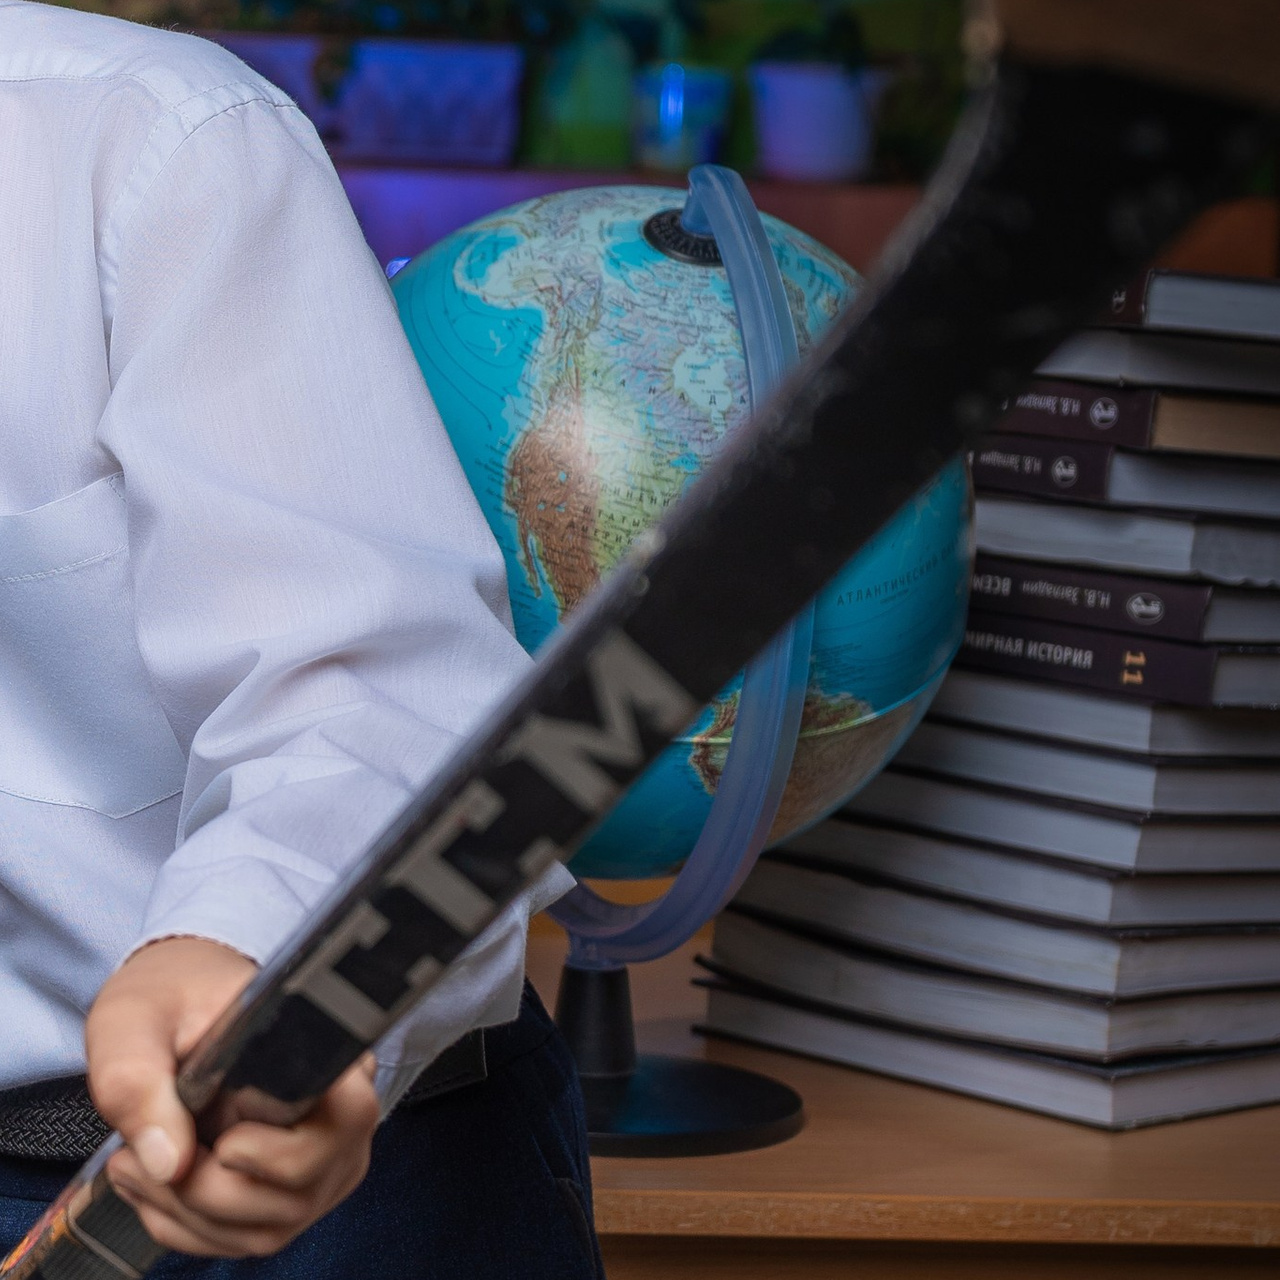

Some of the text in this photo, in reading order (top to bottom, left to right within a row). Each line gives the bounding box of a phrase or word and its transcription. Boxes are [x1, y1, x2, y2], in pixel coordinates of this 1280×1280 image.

[592, 368, 747, 406] КАНАДА
[583, 505, 640, 528] ШТАТЫ
[567, 519, 634, 546] АМЕРИК
[1027, 639, 1095, 670] ИСТОРИЯ
[285, 625, 704, 1042] CCM
